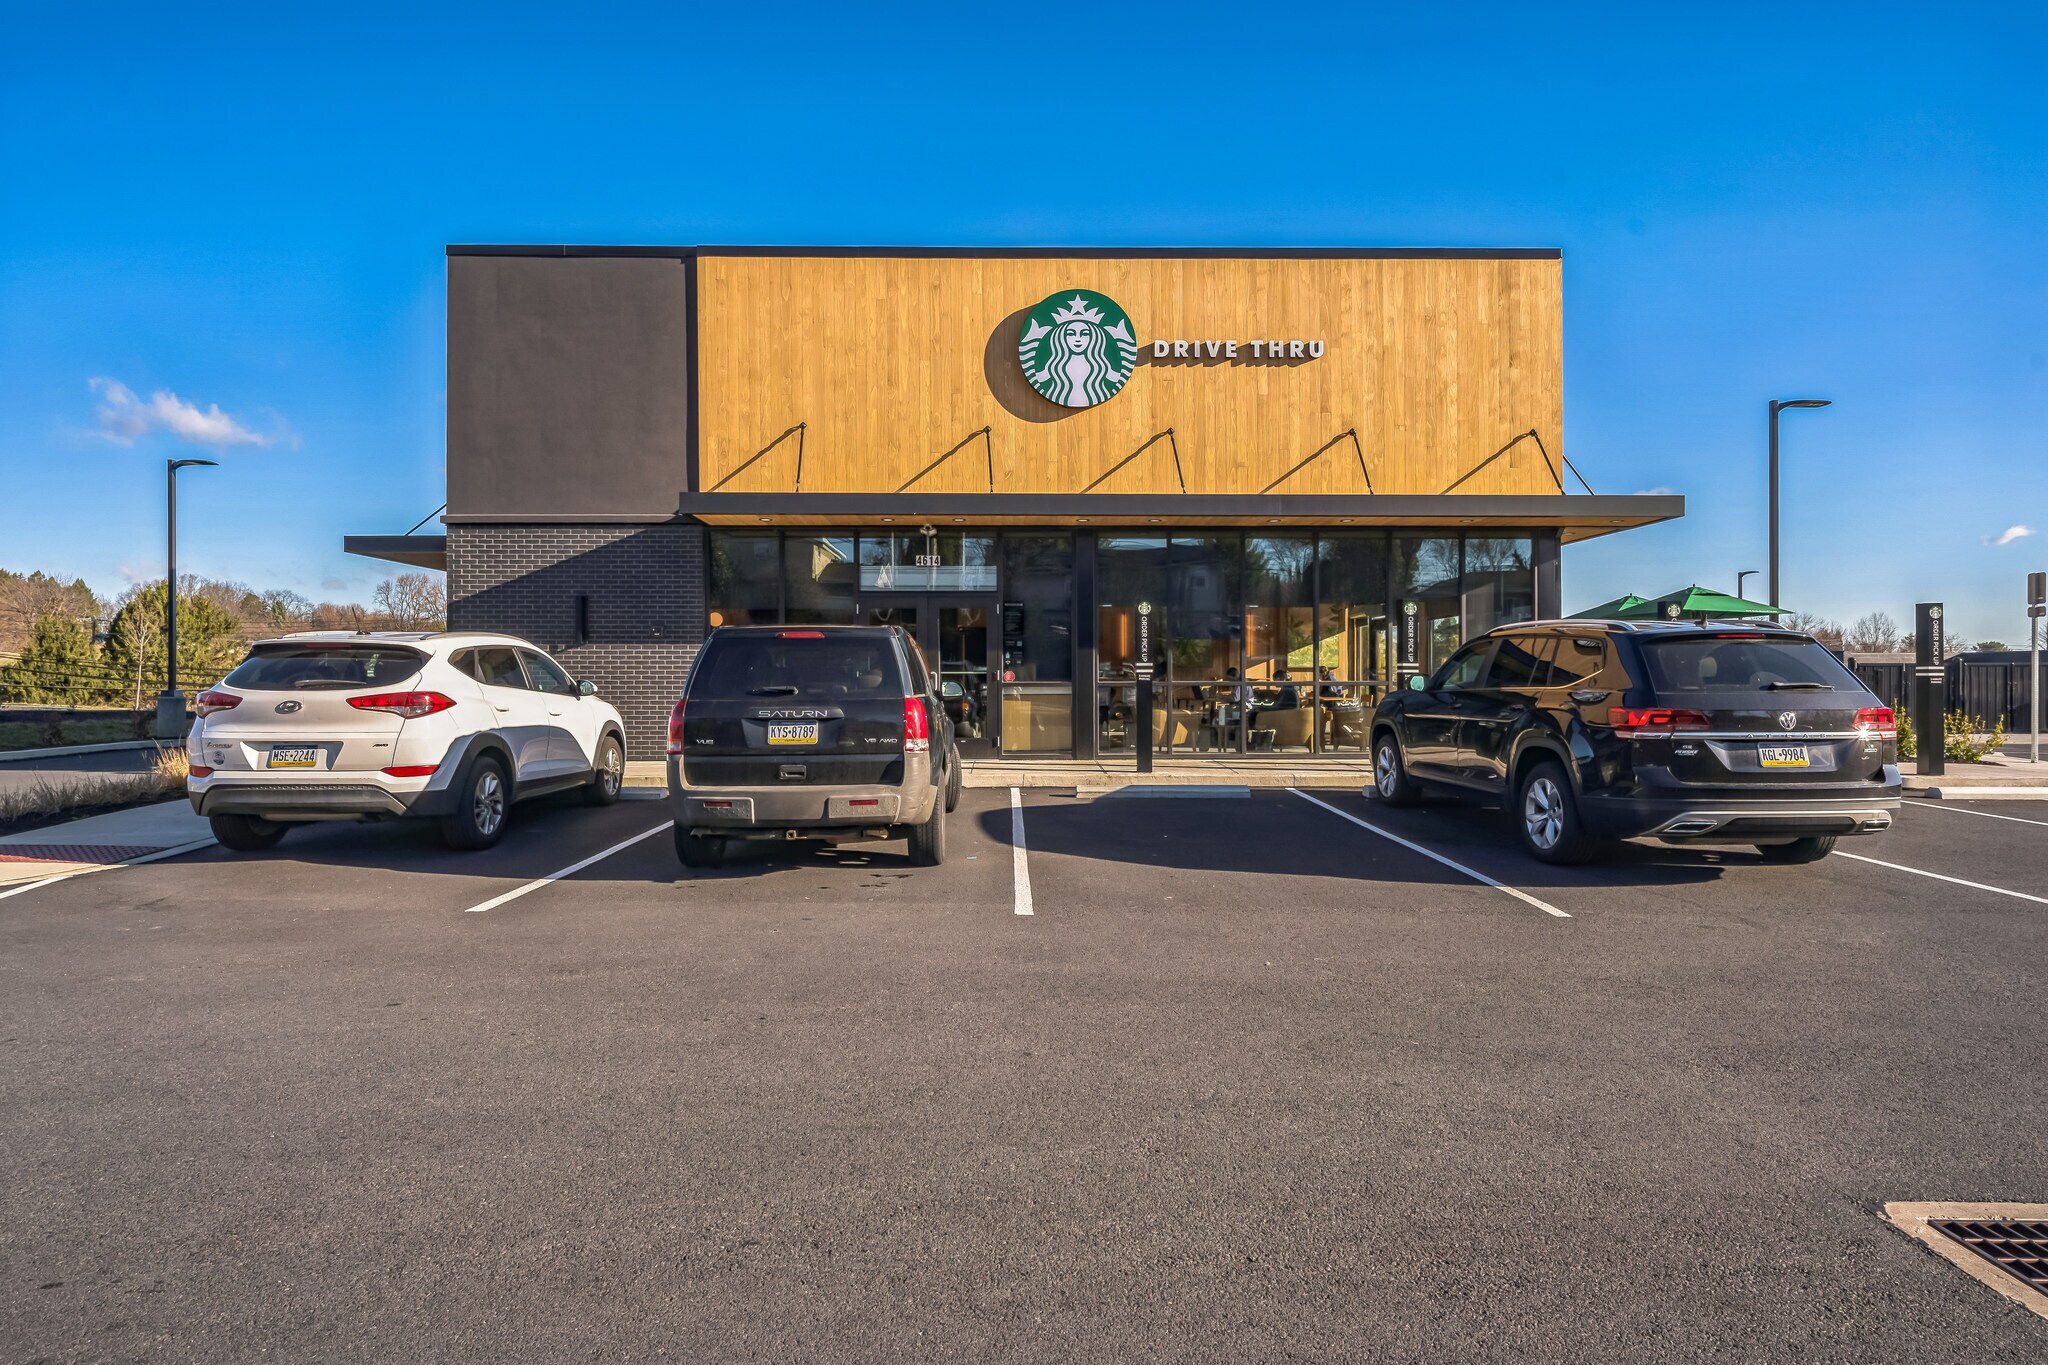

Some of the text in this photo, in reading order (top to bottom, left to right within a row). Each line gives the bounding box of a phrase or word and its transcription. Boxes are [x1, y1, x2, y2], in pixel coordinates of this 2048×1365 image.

[1154, 339, 1324, 358] DRIVE THRU
[916, 555, 940, 566] 4614
[1141, 653, 1148, 662] UP
[1407, 653, 1414, 662] UP
[1932, 656, 1939, 666] UP
[758, 710, 828, 718] SATURN
